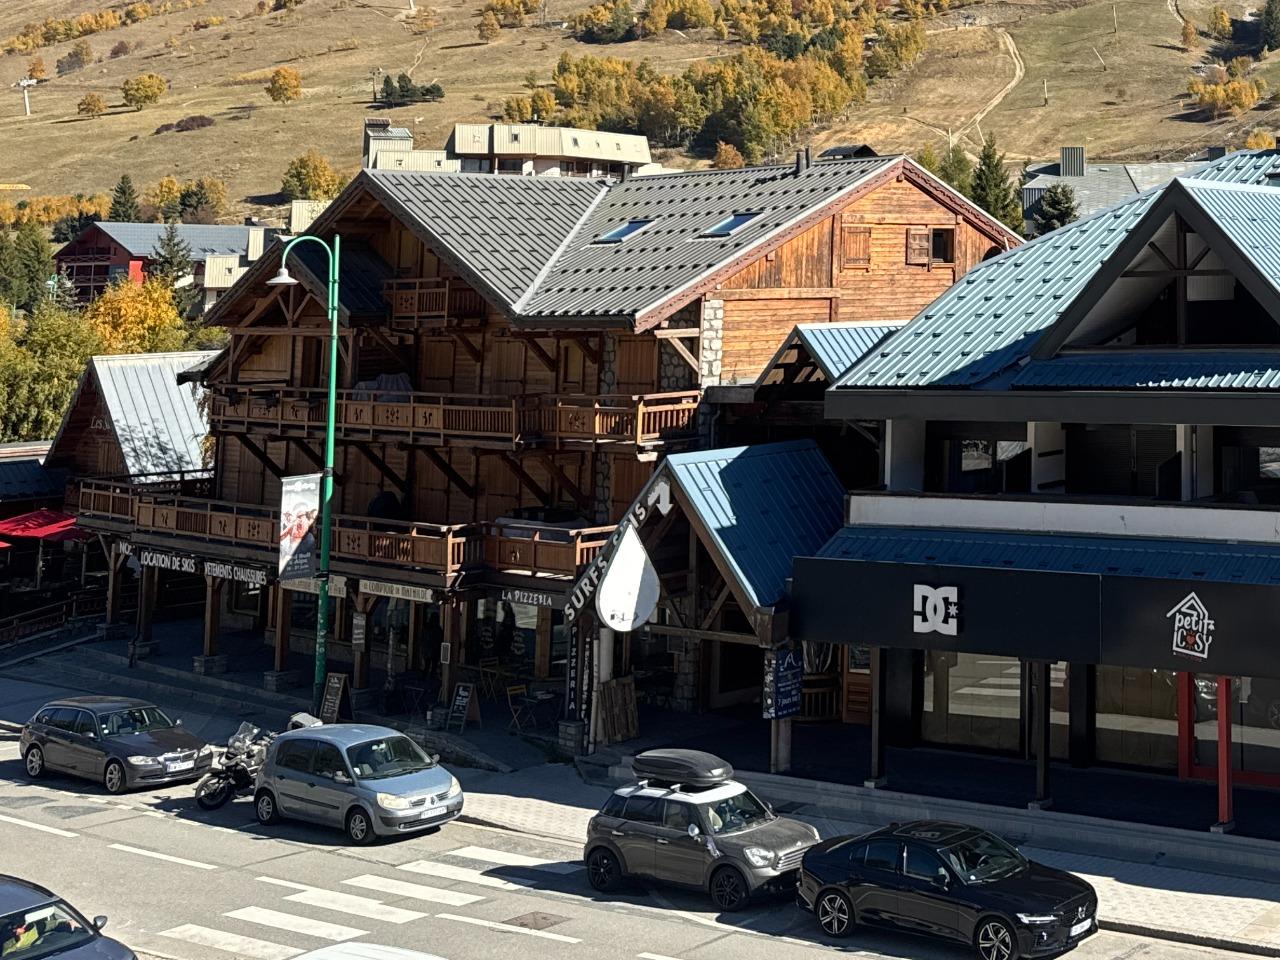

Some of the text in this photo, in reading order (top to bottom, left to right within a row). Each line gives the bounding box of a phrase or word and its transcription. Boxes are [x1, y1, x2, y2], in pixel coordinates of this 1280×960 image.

[140, 551, 196, 573] LOCATION DE SKIS
[233, 566, 267, 586] CHAUSSURES
[501, 590, 553, 607] LA PIZZERIA
[564, 556, 609, 621] SURFS
[568, 626, 578, 710] PIZZERIA
